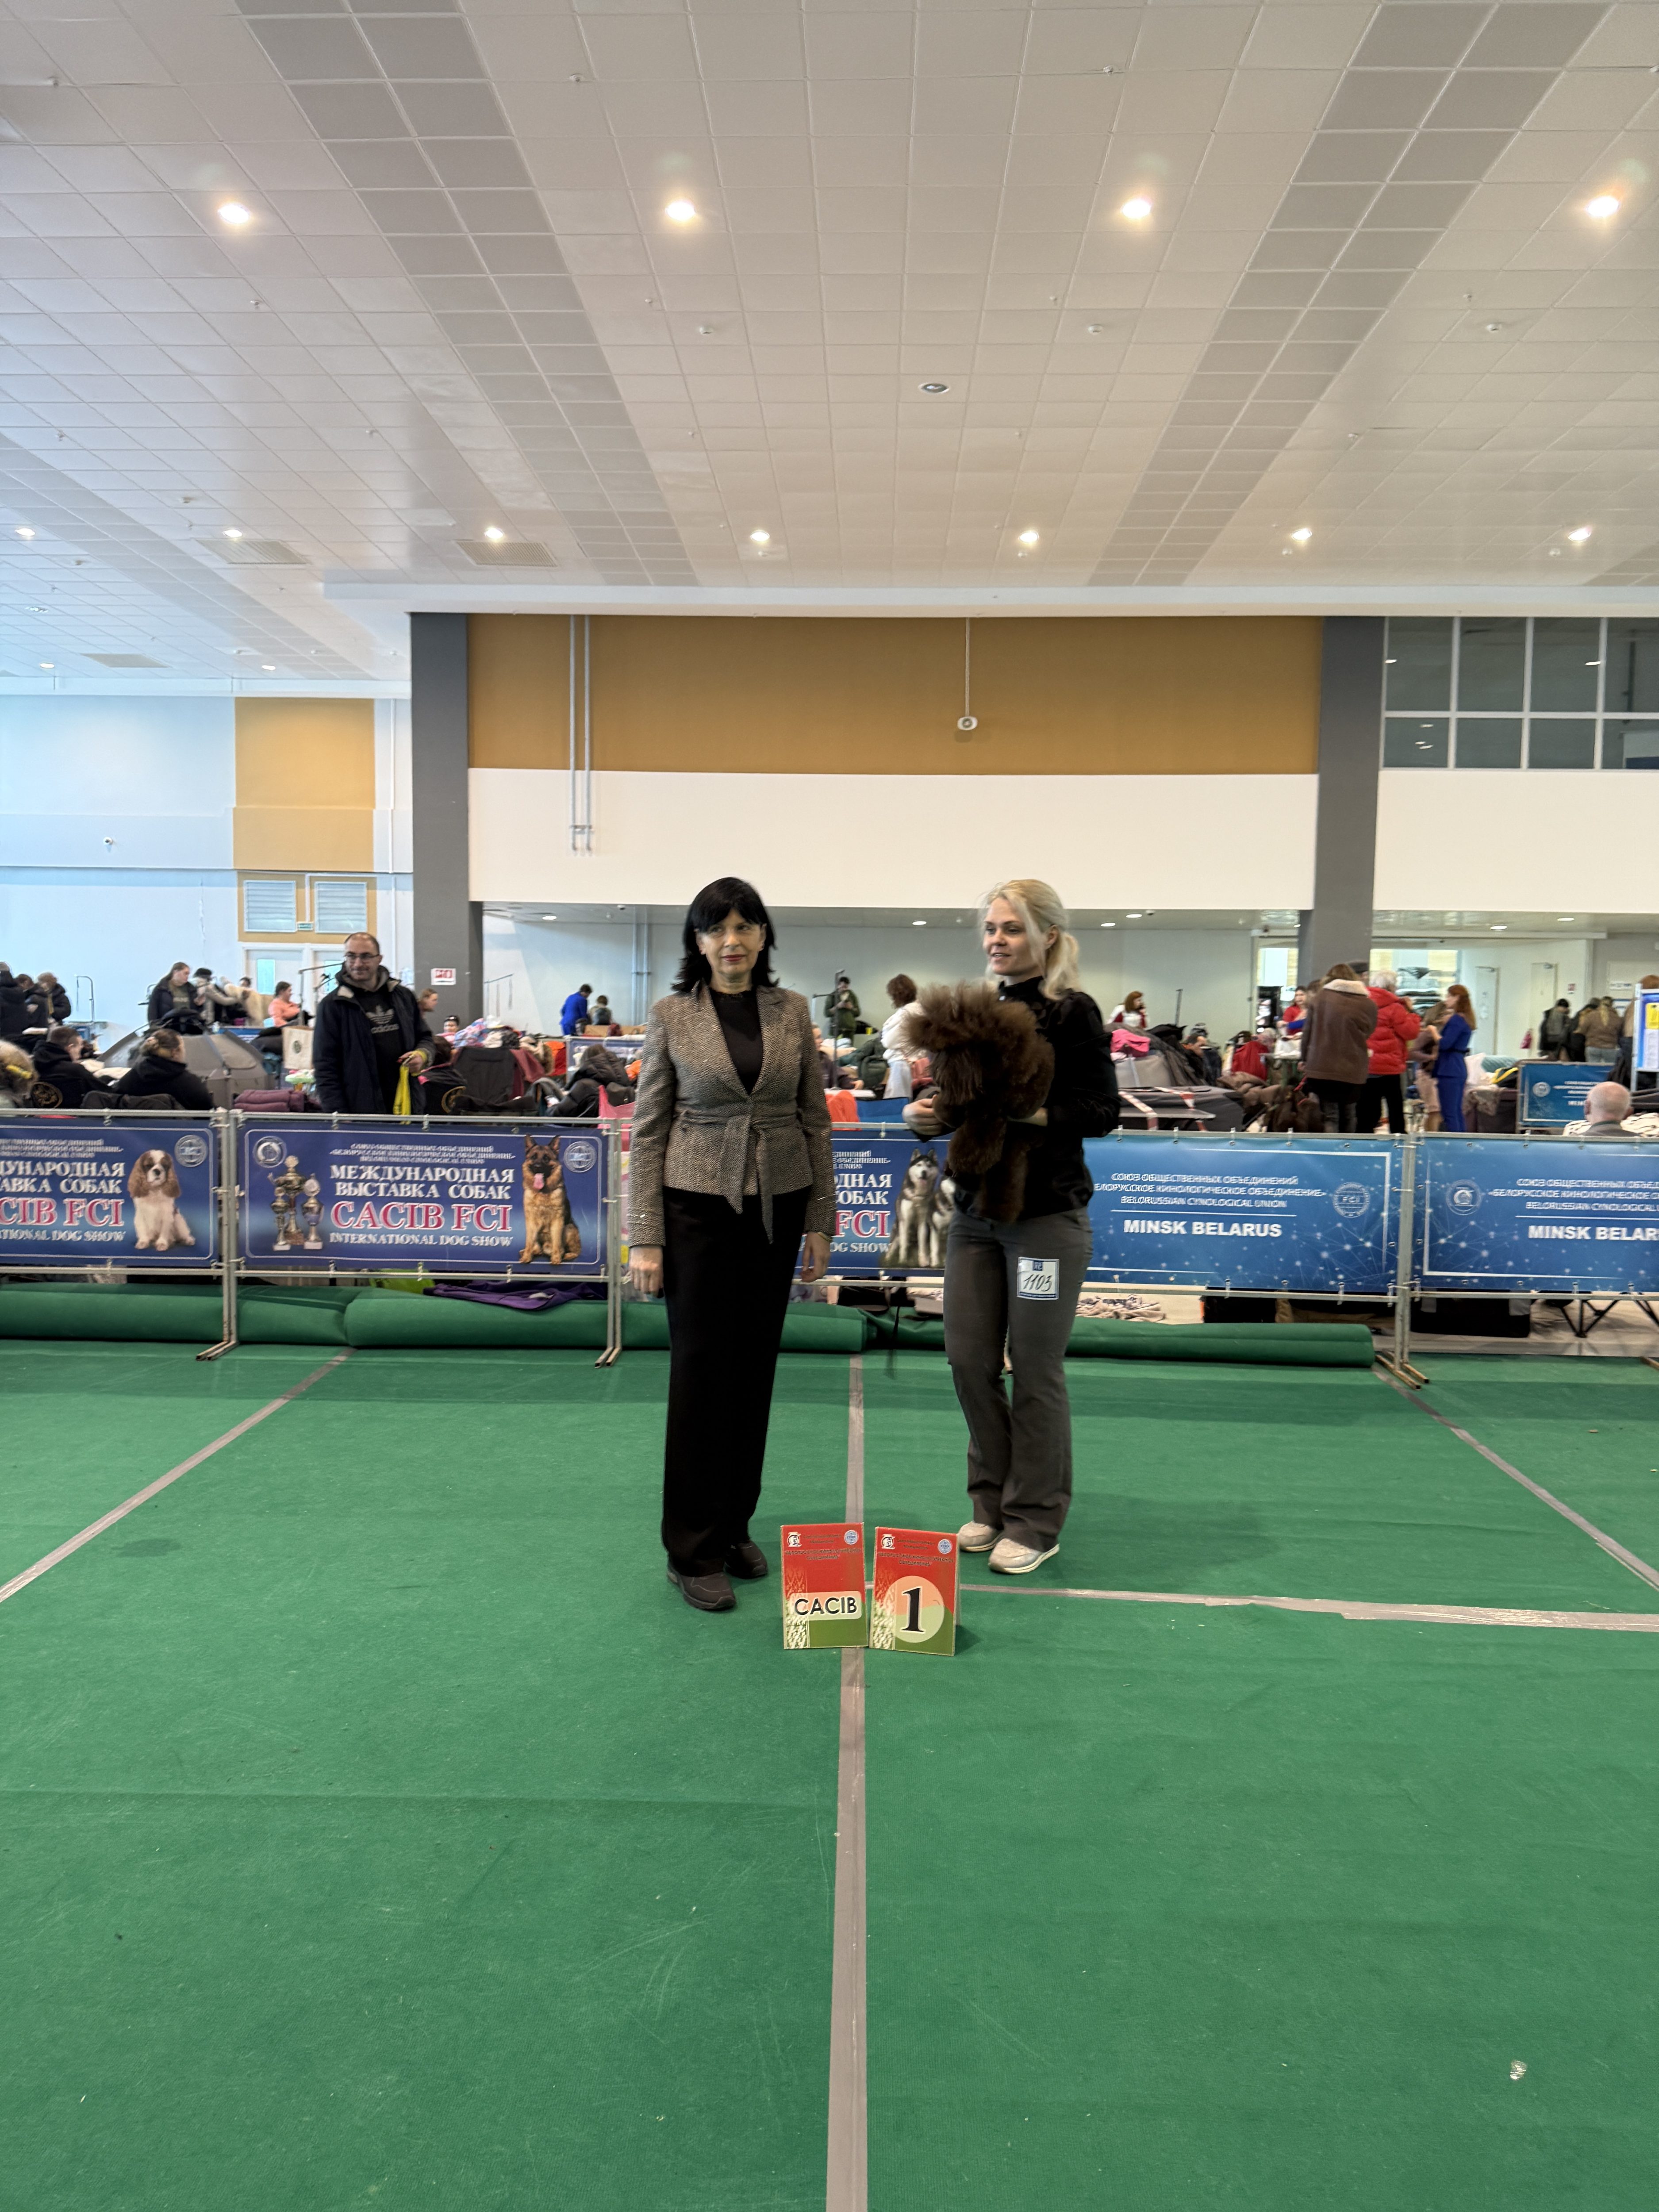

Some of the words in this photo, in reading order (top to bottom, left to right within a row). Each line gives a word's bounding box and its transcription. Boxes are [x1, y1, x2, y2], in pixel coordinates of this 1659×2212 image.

[330, 1164, 515, 1184] МЕЖДУНАРОДНАЯ
[0, 1177, 52, 1193] АВКА
[59, 1178, 122, 1194] СОБАК
[335, 1182, 440, 1198] ВЫСТАВКА
[448, 1184, 511, 1199] СОБАК
[1094, 1183, 1156, 1192] ЕЛОРУССКОЕ
[836, 1190, 888, 1205] ОБАК
[63, 1198, 124, 1227] FCI
[331, 1201, 444, 1230] CACIB
[451, 1203, 513, 1232] FCI
[832, 1210, 891, 1238] FCI
[1124, 1220, 1187, 1234] MINSK
[1192, 1222, 1282, 1237] BELARUS
[52, 1230, 82, 1241] DOG
[84, 1231, 126, 1241] SHOW
[329, 1233, 438, 1245] INTERNATIONAL
[439, 1235, 469, 1246] DOG
[471, 1236, 514, 1247] SHOW
[1528, 1225, 1592, 1239] MINSK
[1595, 1227, 1659, 1241] BELAR
[830, 1242, 848, 1252] OG
[850, 1242, 892, 1253] SHOW
[1023, 1274, 1052, 1292] 1103
[795, 1597, 857, 1616] CACIB
[903, 1587, 925, 1632] 1
